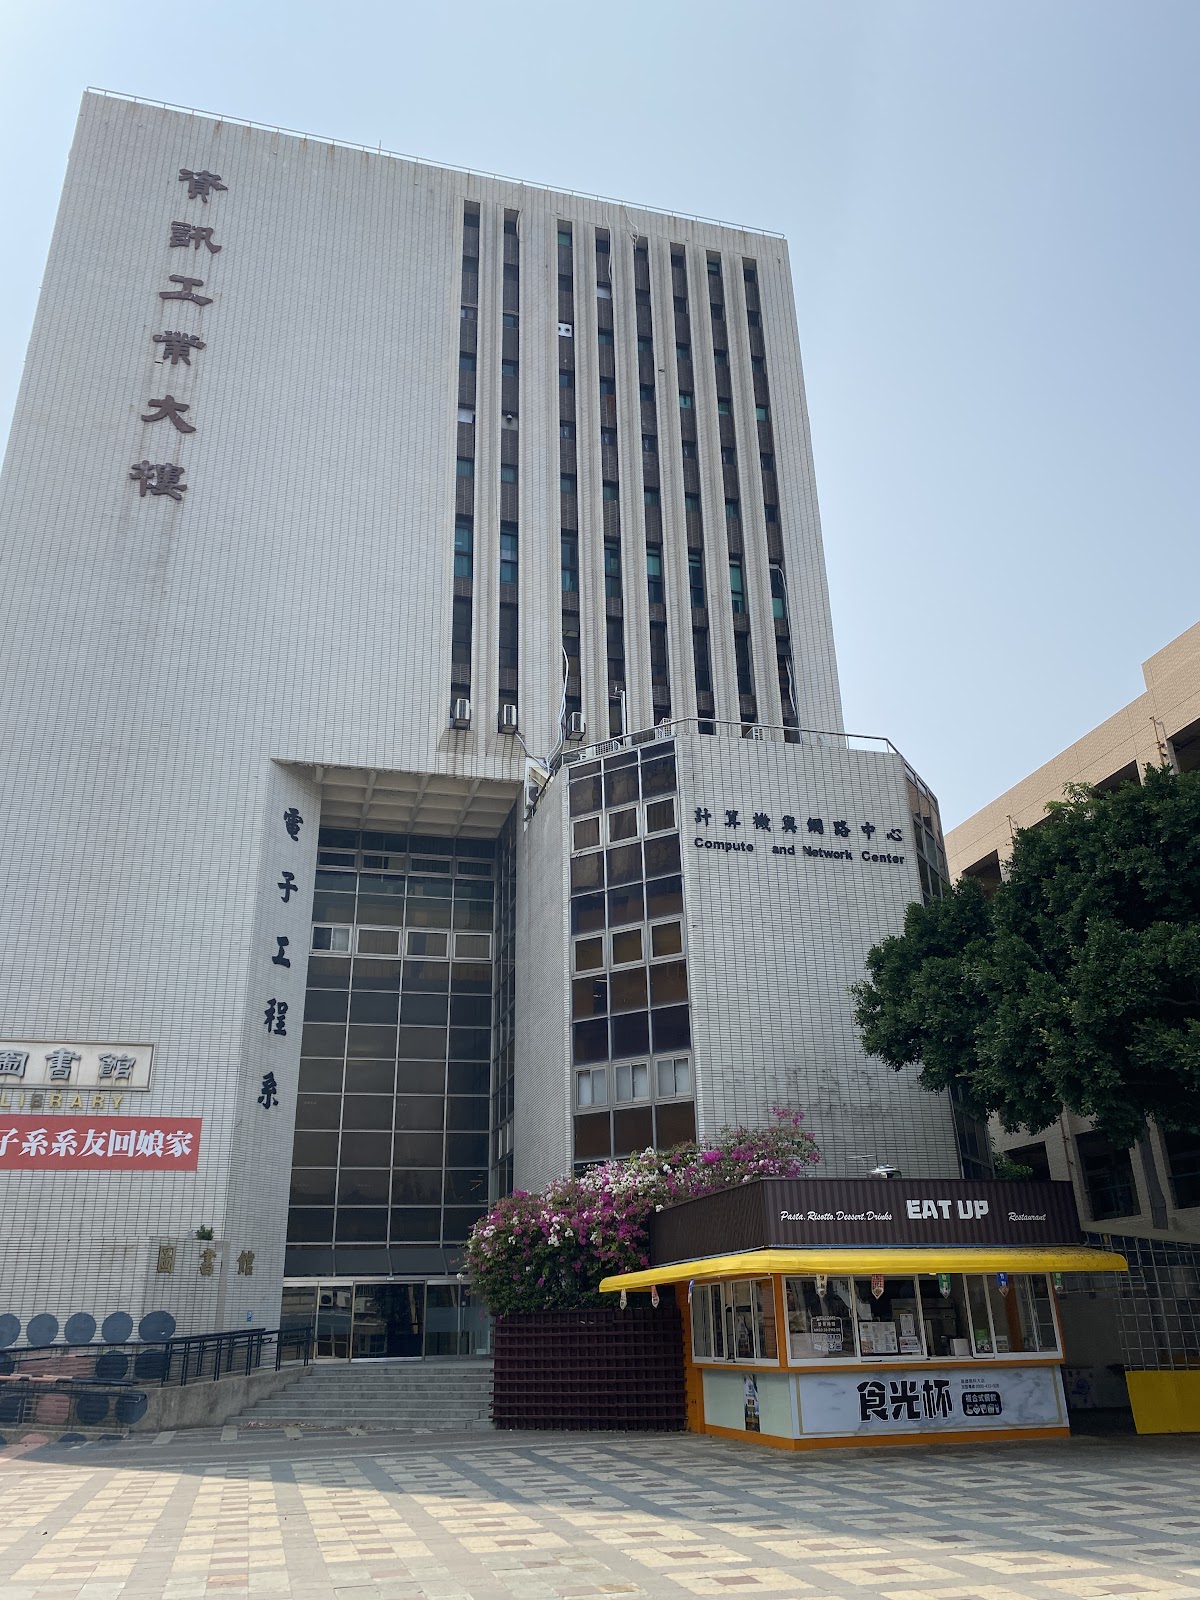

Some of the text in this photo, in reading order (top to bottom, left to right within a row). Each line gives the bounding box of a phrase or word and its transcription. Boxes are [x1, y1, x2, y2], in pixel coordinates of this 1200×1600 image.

[129, 168, 229, 501] 資訊工業大樓
[694, 807, 903, 842] 計算機與網路中心
[694, 837, 905, 865] Compute and Network Center
[257, 807, 304, 1110] 電子工程系
[0, 1092, 124, 1110] LIBRARY
[906, 1199, 990, 1220] EAT UP
[1007, 1211, 1047, 1222] Restaurant
[157, 1245, 255, 1276] 圖書館
[856, 1379, 954, 1423] 食光杯
